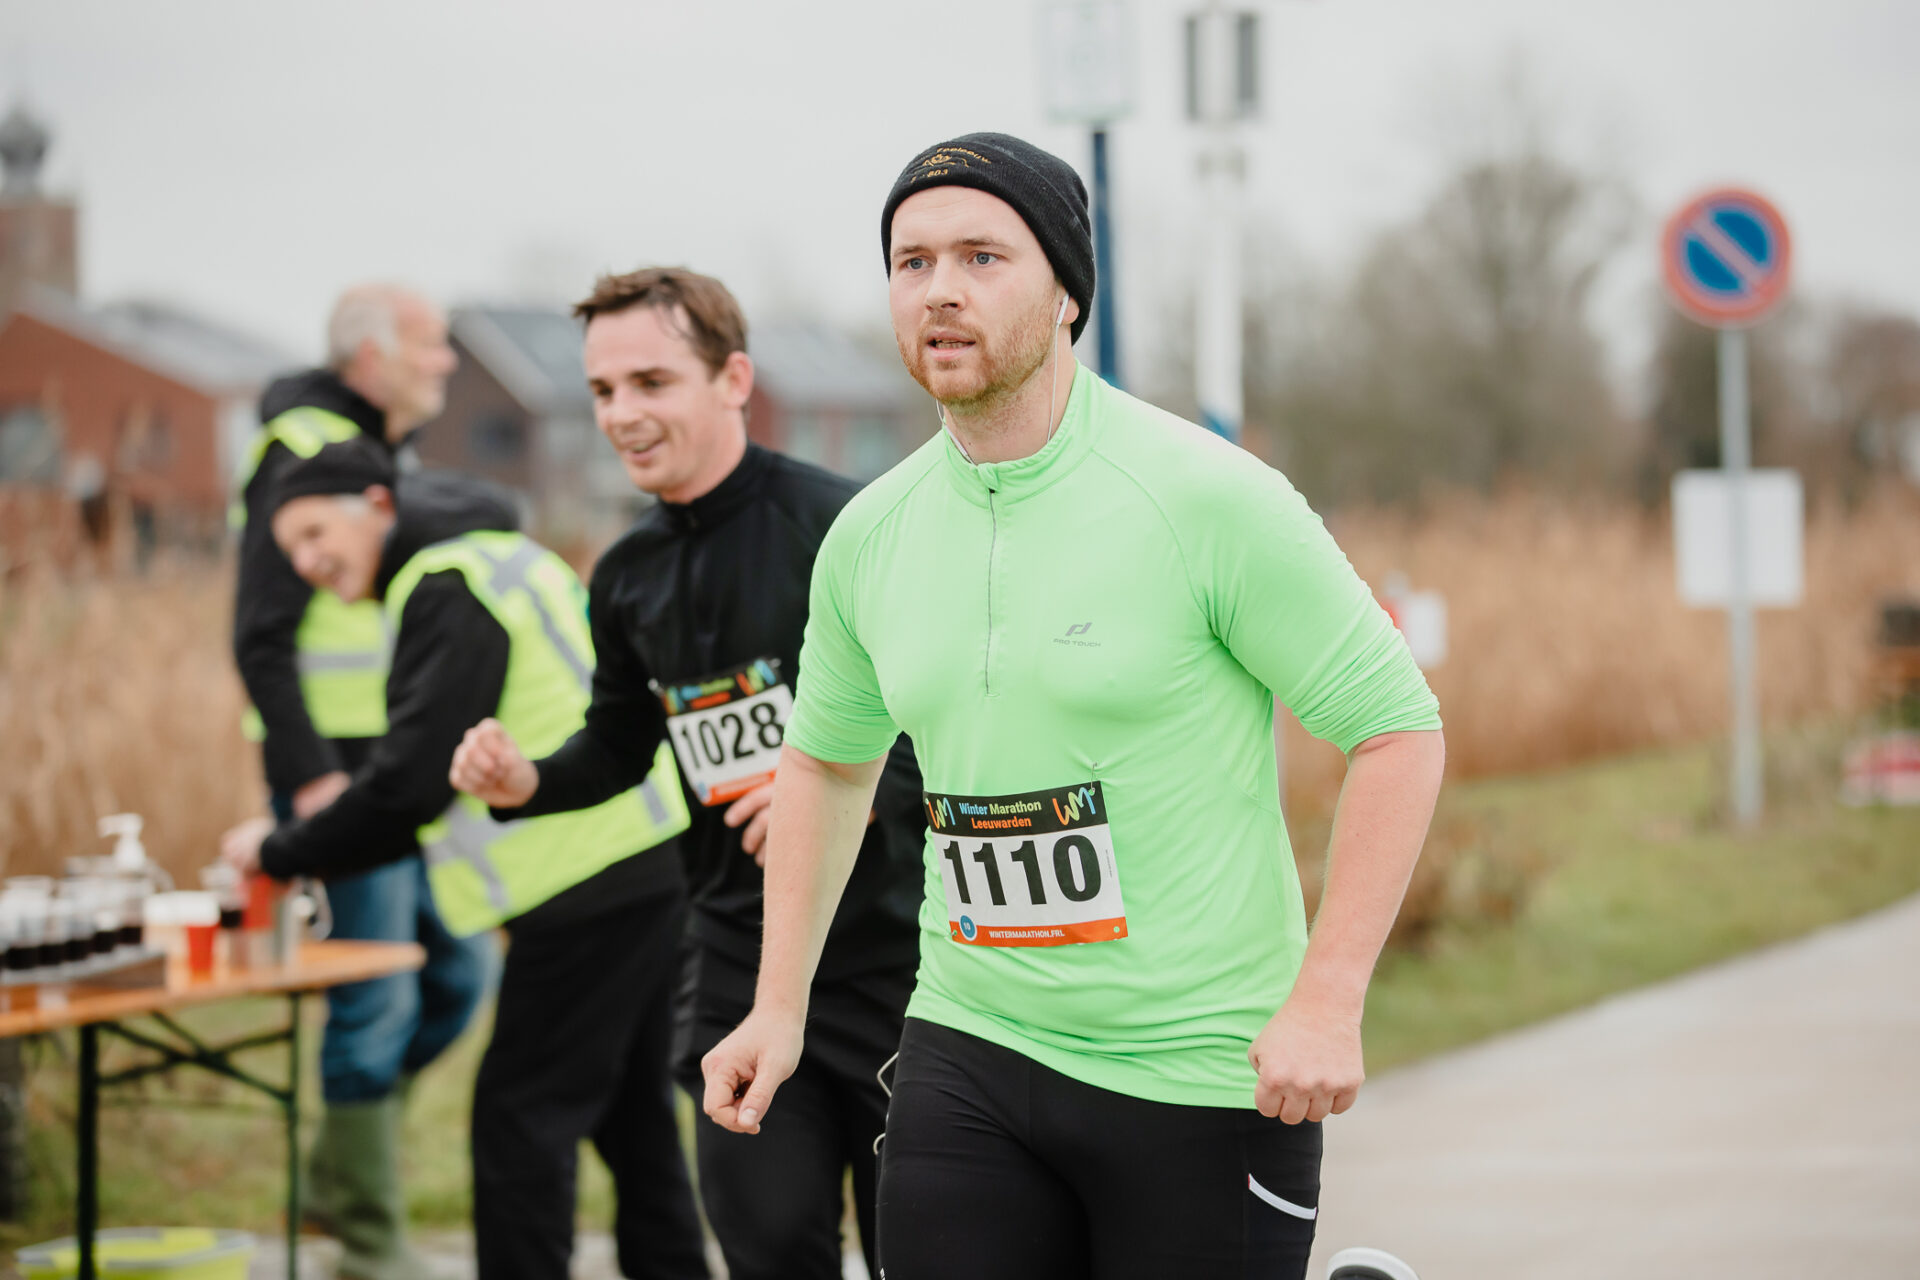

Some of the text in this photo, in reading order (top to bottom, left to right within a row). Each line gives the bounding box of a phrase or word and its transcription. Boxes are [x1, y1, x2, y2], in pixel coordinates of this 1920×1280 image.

[681, 702, 785, 769] 1028
[958, 800, 1042, 816] Winter Marathon
[971, 816, 1032, 830] Leeuwarden
[943, 834, 1102, 906] 1110
[988, 930, 1065, 939] WINTERMARATHON.FRL
